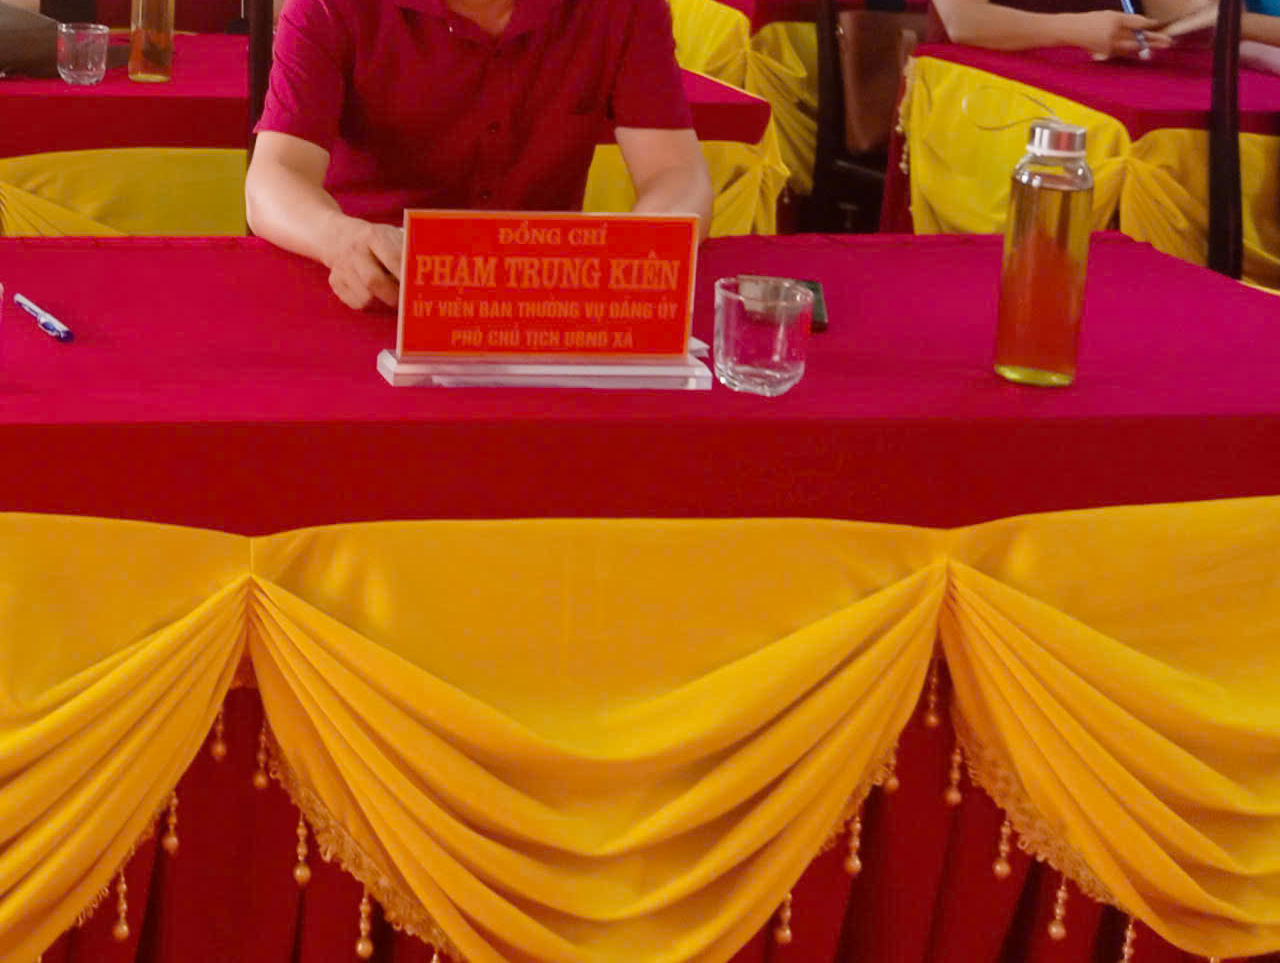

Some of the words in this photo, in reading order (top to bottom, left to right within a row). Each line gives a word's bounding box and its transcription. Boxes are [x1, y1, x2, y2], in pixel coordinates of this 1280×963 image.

[498, 220, 561, 245] ĐỒNG
[568, 222, 608, 245] CHÍ
[415, 254, 497, 294] PHẠM
[504, 256, 601, 290] TRUNG
[608, 249, 681, 291] KIÊN
[479, 300, 513, 318] BAN
[564, 330, 608, 349] UBND
